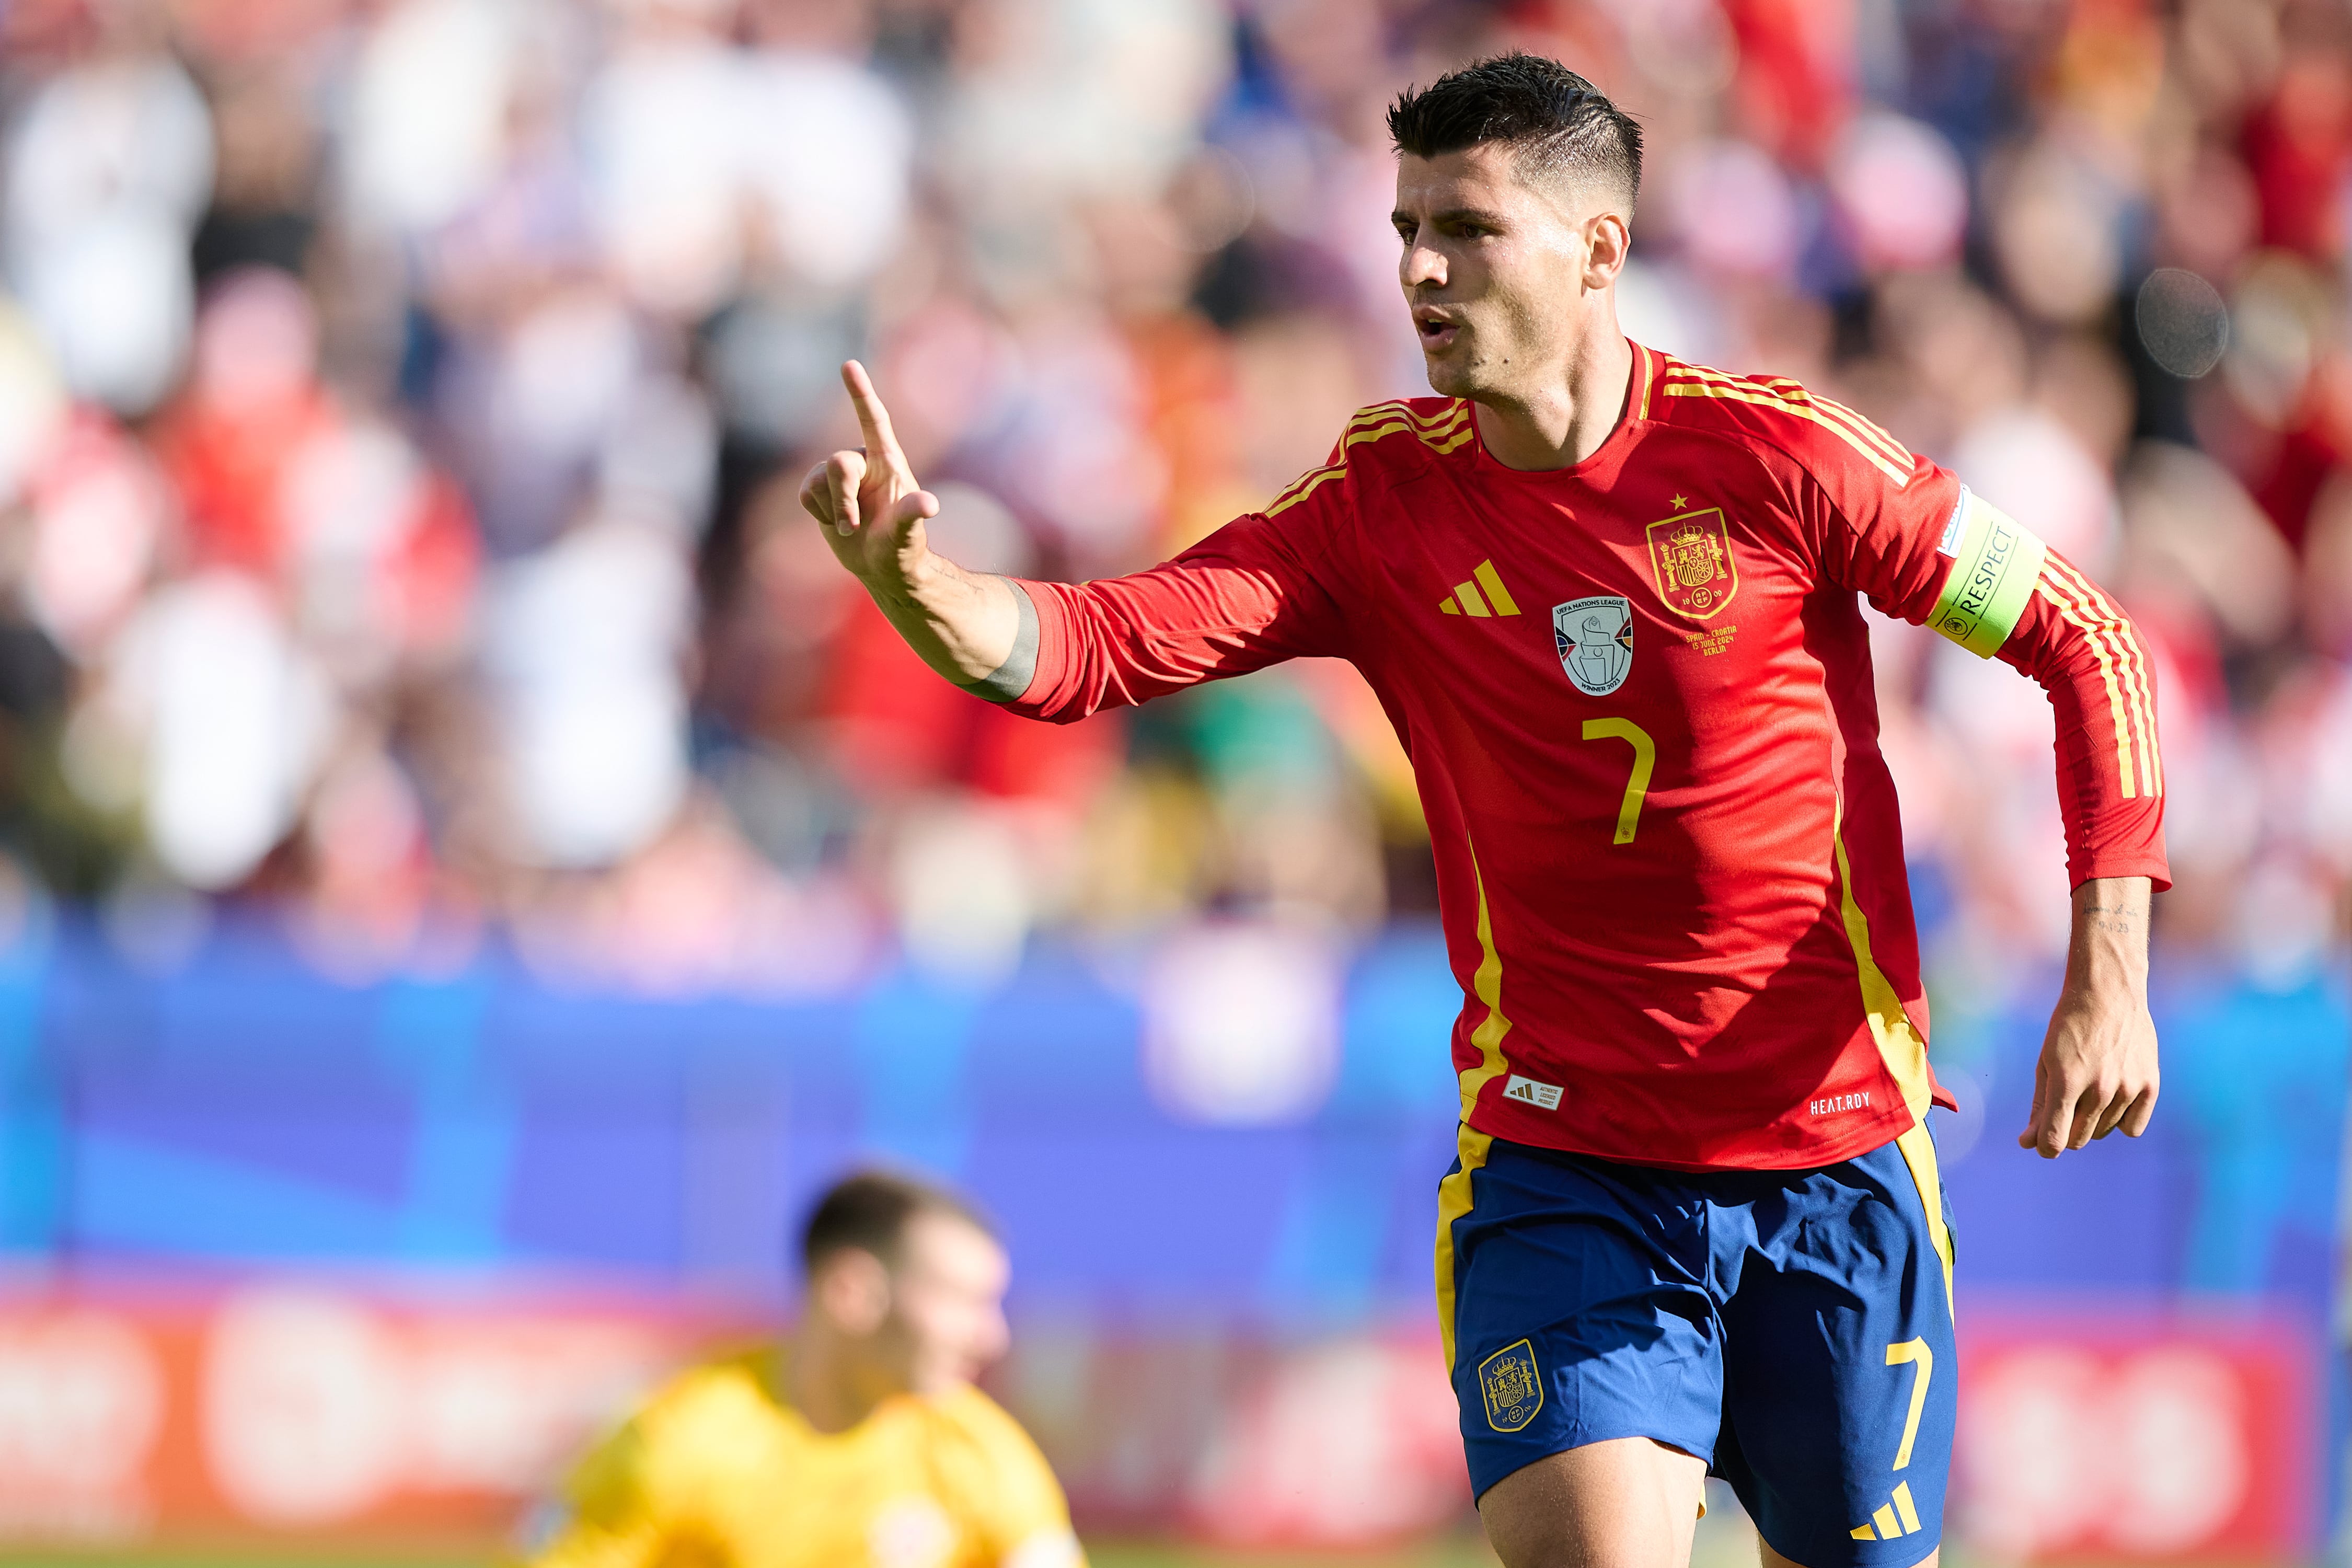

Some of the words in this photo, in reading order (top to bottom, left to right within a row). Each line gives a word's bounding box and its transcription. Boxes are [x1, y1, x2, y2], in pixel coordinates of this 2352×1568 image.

[1960, 526, 2011, 615] RESPECT
[1557, 606, 1572, 614] UEFA
[1573, 600, 1599, 608] NATIONS
[1686, 632, 1704, 643] SPAIN
[1711, 625, 1737, 637] CROATIA
[1700, 639, 1716, 648] JUNE
[1717, 635, 1734, 645] 2024
[1703, 645, 1726, 656] BERLIN
[1582, 682, 1606, 692] WINNER
[1607, 678, 1620, 689] 2023
[1582, 717, 1656, 845] 7
[1811, 1091, 1869, 1115] HEAT.RDY
[1885, 1335, 1933, 1472] 7
